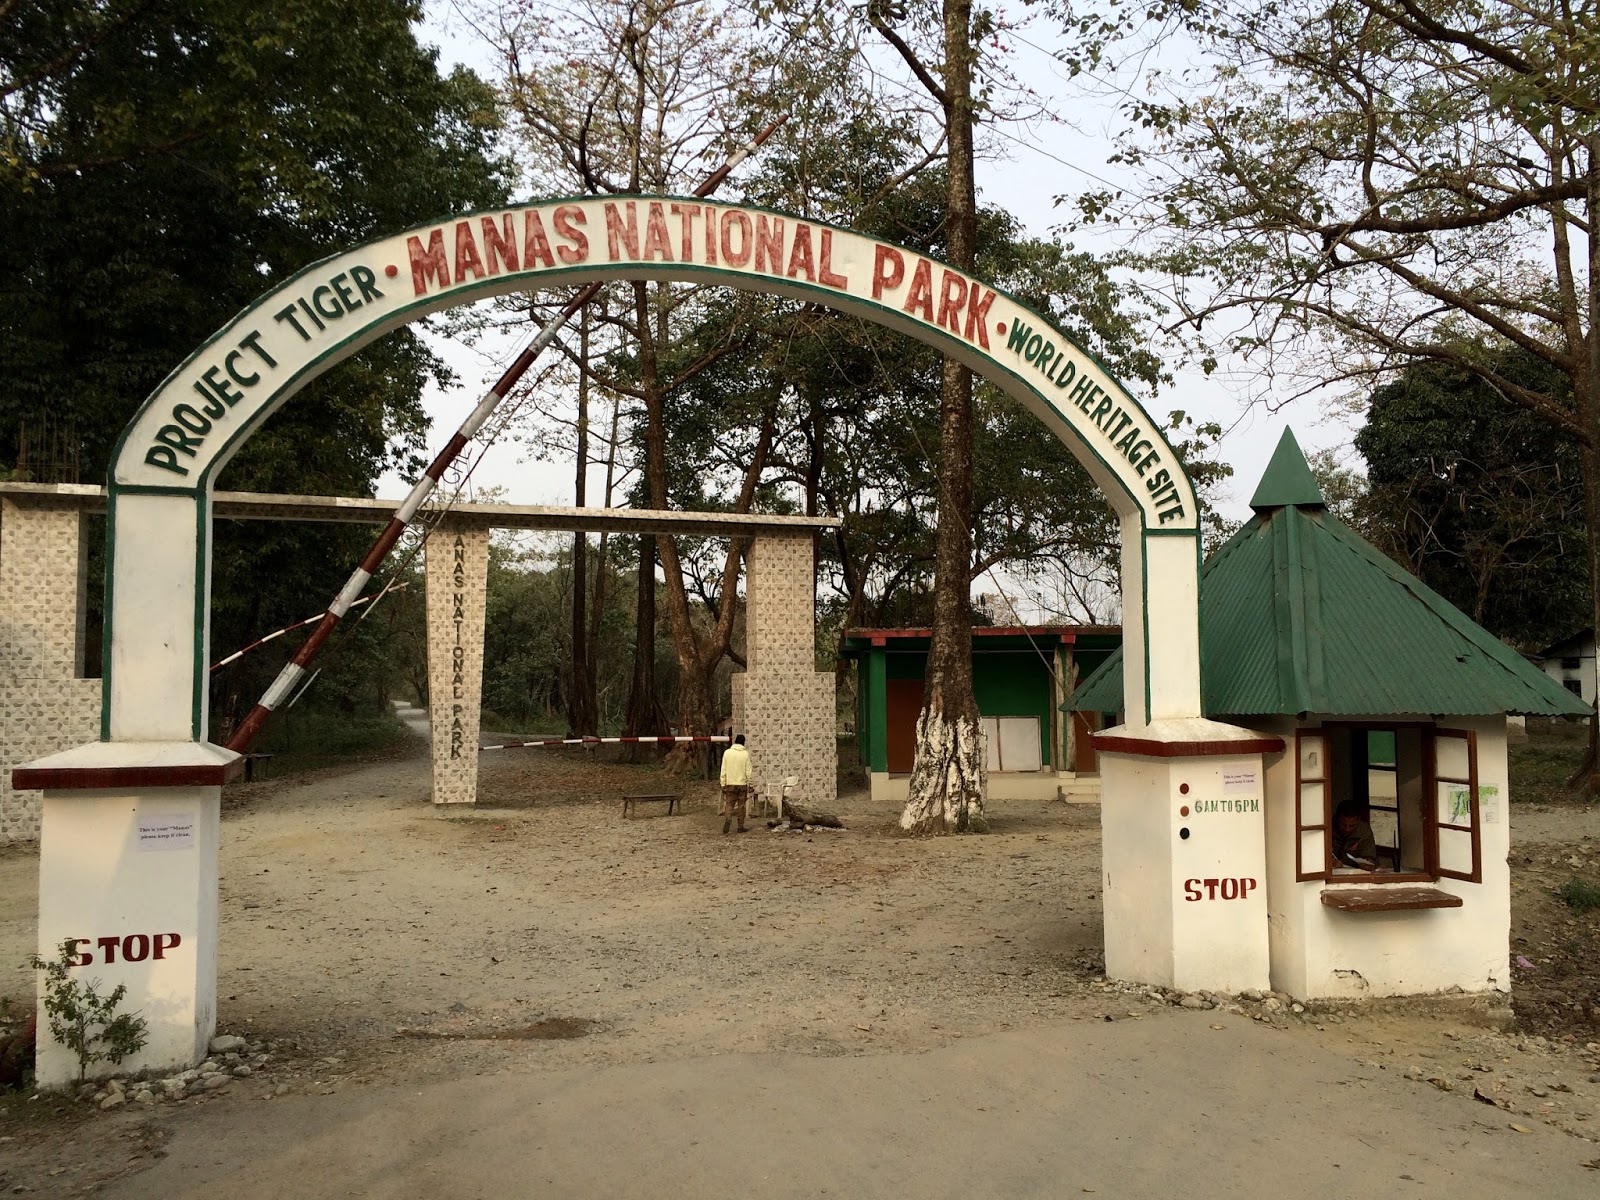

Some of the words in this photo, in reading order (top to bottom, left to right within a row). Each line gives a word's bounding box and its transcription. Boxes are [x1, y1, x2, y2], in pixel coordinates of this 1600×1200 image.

[144, 330, 278, 476] PROJECT
[273, 265, 385, 342] TIGER
[406, 204, 589, 297] MANAS
[604, 201, 848, 291] NATIONAL
[872, 244, 997, 351] PARK
[1004, 316, 1076, 388] WORLD
[1072, 374, 1162, 477] HERITAGE
[1145, 458, 1186, 525] SITE
[453, 523, 466, 588] ANAS
[452, 593, 465, 699] NATIONAL
[451, 704, 463, 759] PARK
[1184, 878, 1257, 902] STOP
[66, 933, 182, 967] STOP
